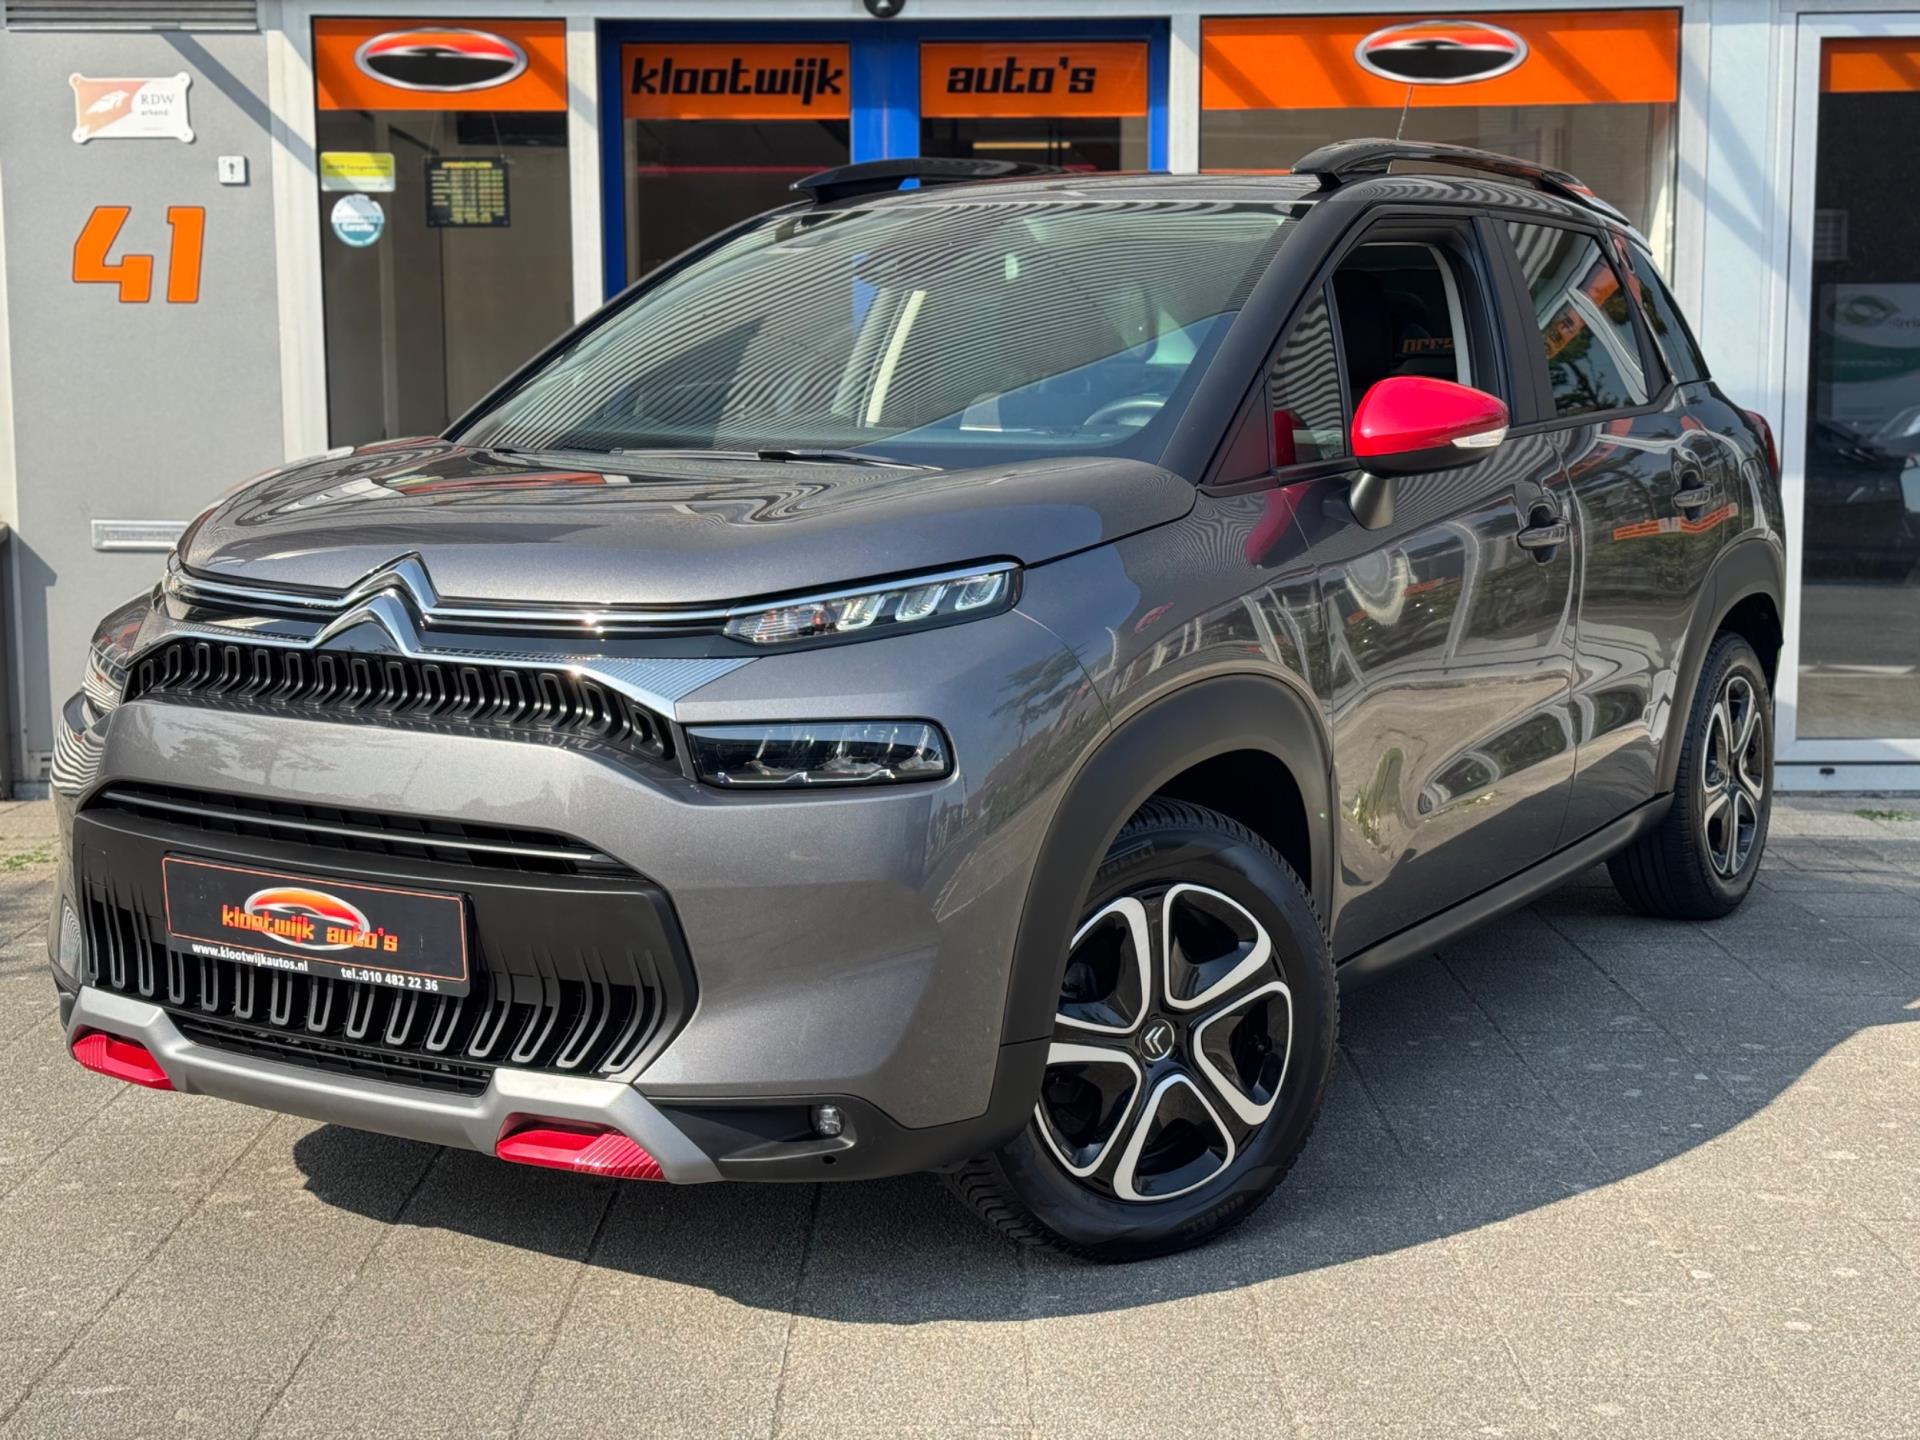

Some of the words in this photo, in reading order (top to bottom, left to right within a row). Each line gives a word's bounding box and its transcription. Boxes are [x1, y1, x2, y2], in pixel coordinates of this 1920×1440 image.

[631, 58, 844, 105] klootwijk
[947, 57, 1096, 93] auto's
[141, 94, 175, 105] RDW
[72, 205, 205, 303] 41
[221, 904, 315, 943] klootwijk
[326, 924, 398, 952] auto's
[192, 944, 308, 971] www.klootwijkautos.nl
[385, 973, 405, 986] 482
[408, 977, 422, 989] 22
[424, 980, 439, 991] 36
